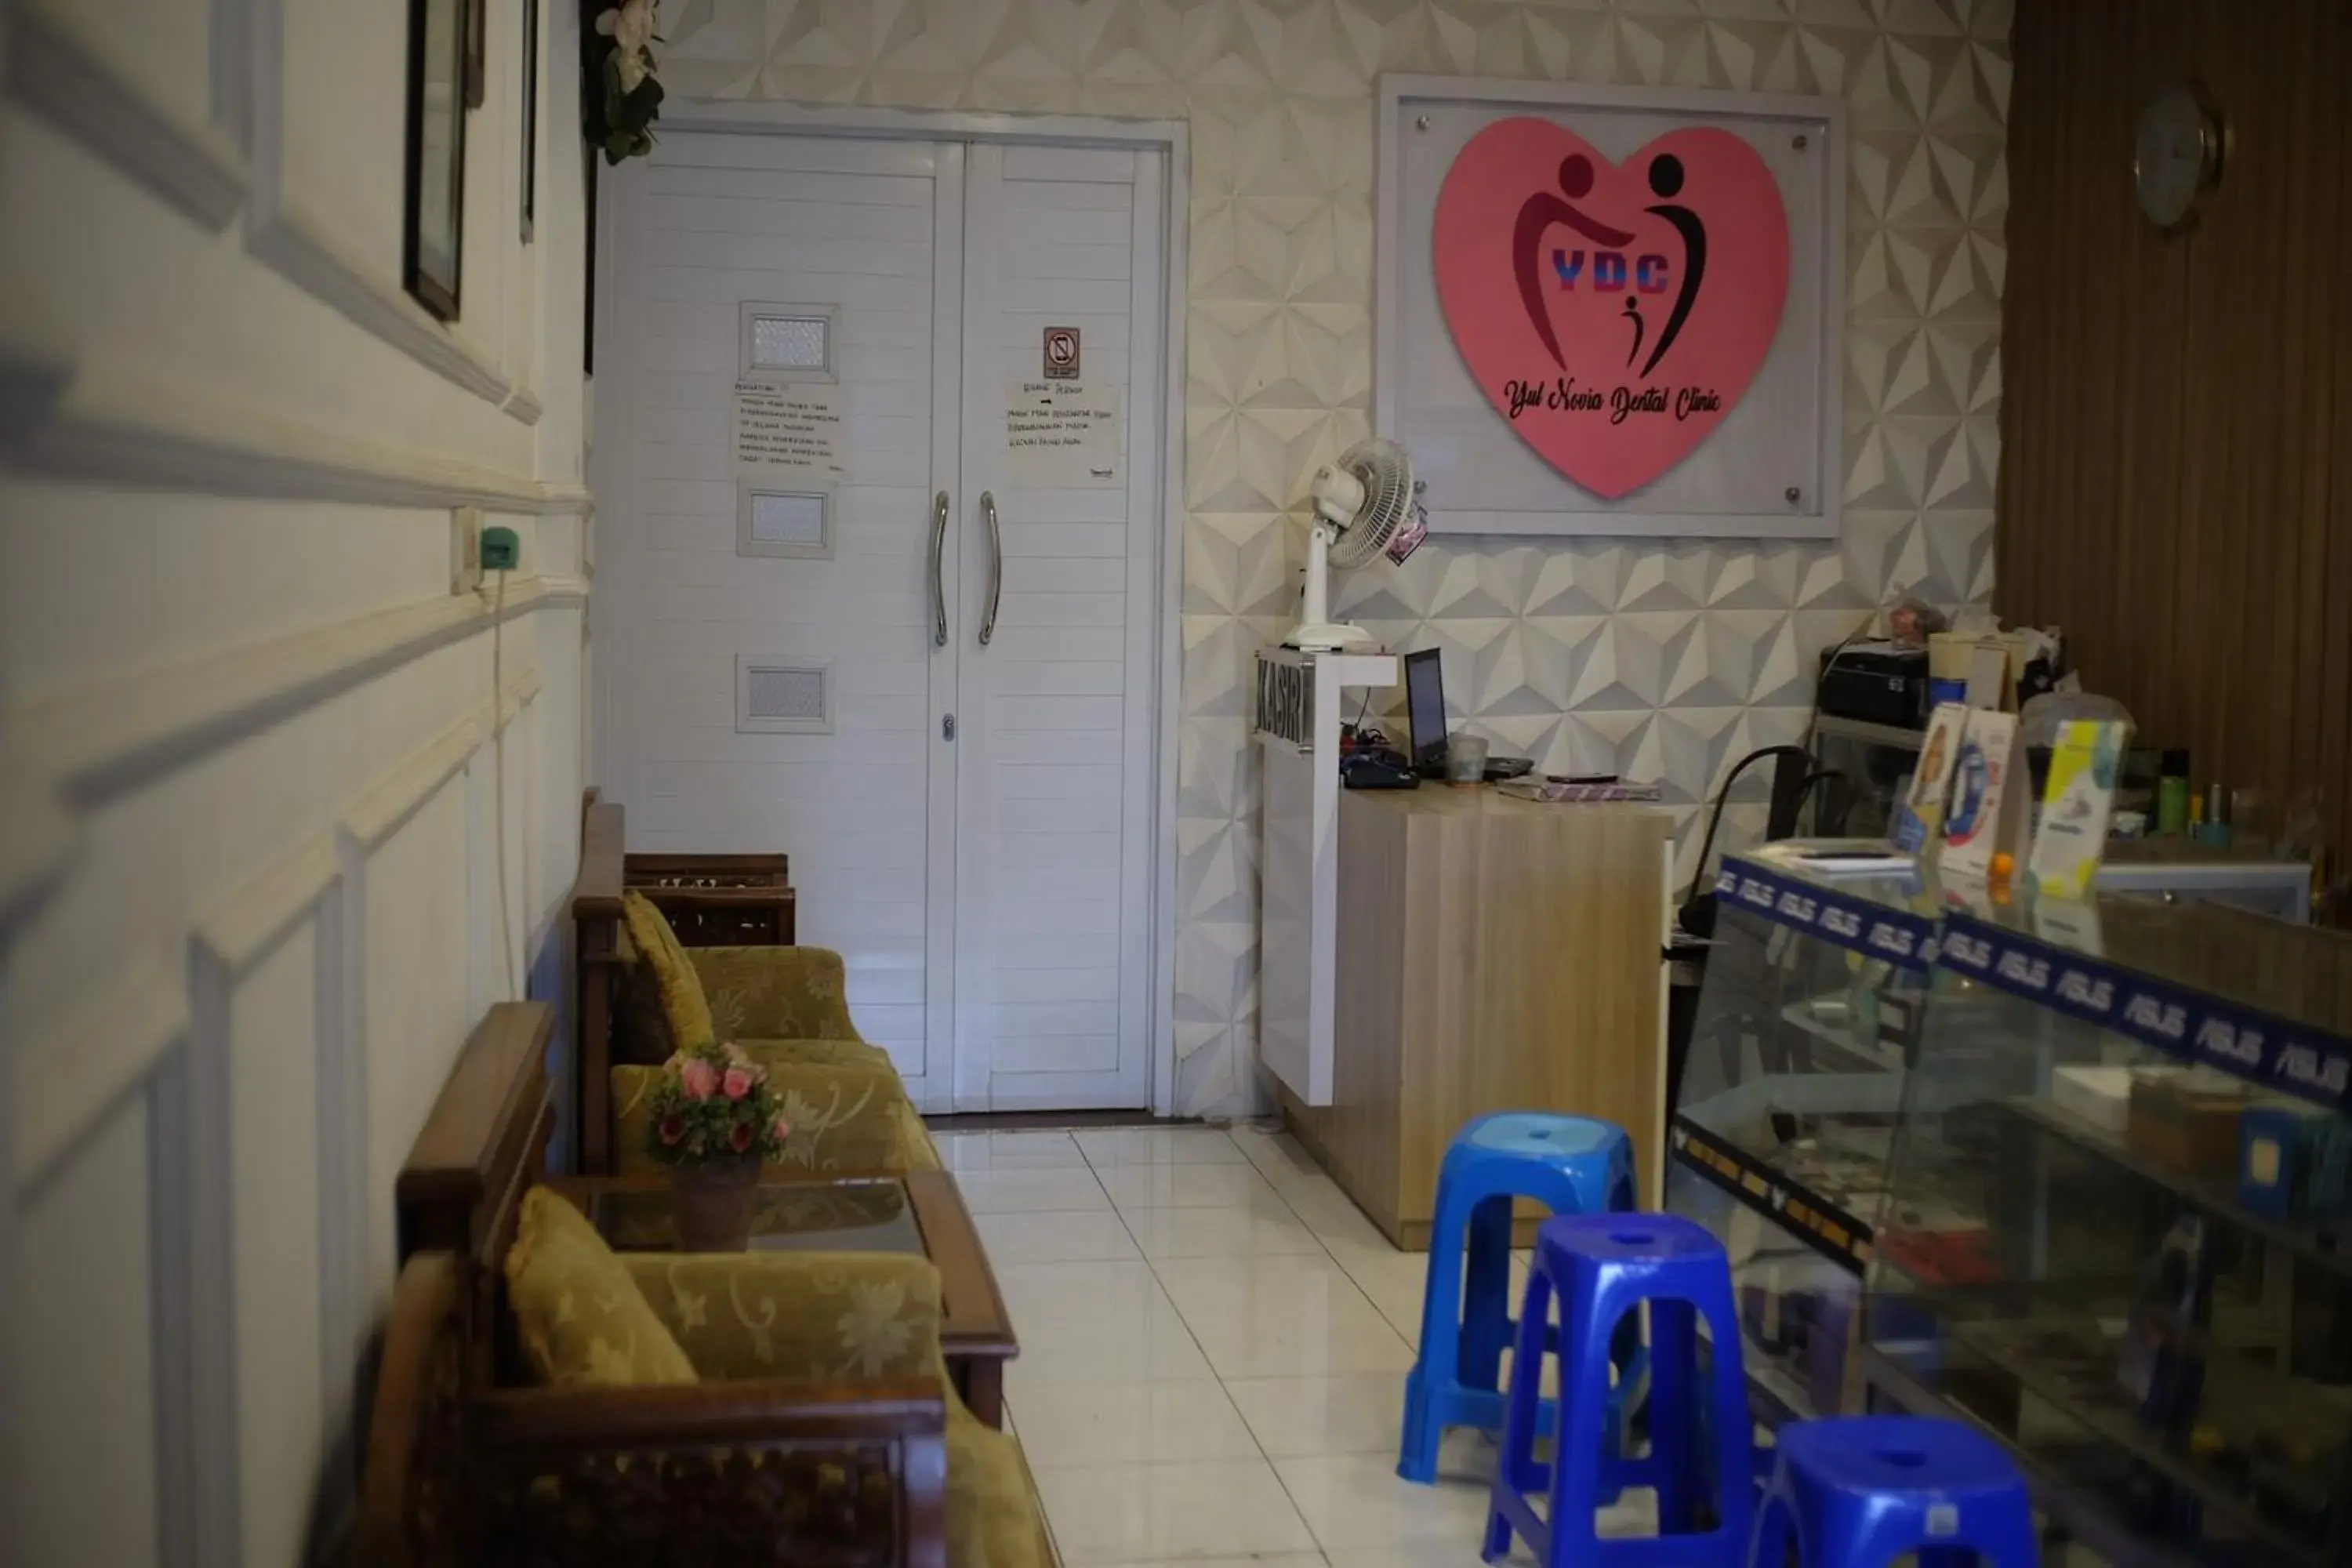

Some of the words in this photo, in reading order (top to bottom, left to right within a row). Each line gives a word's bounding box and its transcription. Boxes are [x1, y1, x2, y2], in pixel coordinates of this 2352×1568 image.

[1552, 249, 1668, 294] YDC
[1504, 379, 1545, 419] Yul
[1548, 377, 1604, 412] Novia
[1610, 386, 1671, 426] Dental
[1675, 386, 1722, 422] Clinic
[1257, 659, 1301, 744] KASIR
[1737, 877, 1776, 908] ASUS
[1776, 891, 1817, 923] ASUS
[1819, 906, 1863, 938] ASUS
[1868, 922, 1915, 956] ASUS
[1941, 931, 1993, 970] ASUS
[1995, 947, 2052, 989] ASUS
[2054, 967, 2116, 1012] ASUS
[2123, 992, 2189, 1039] ASUS
[2195, 1016, 2265, 1065] ASUS
[2275, 1041, 2350, 1094] ASUS
